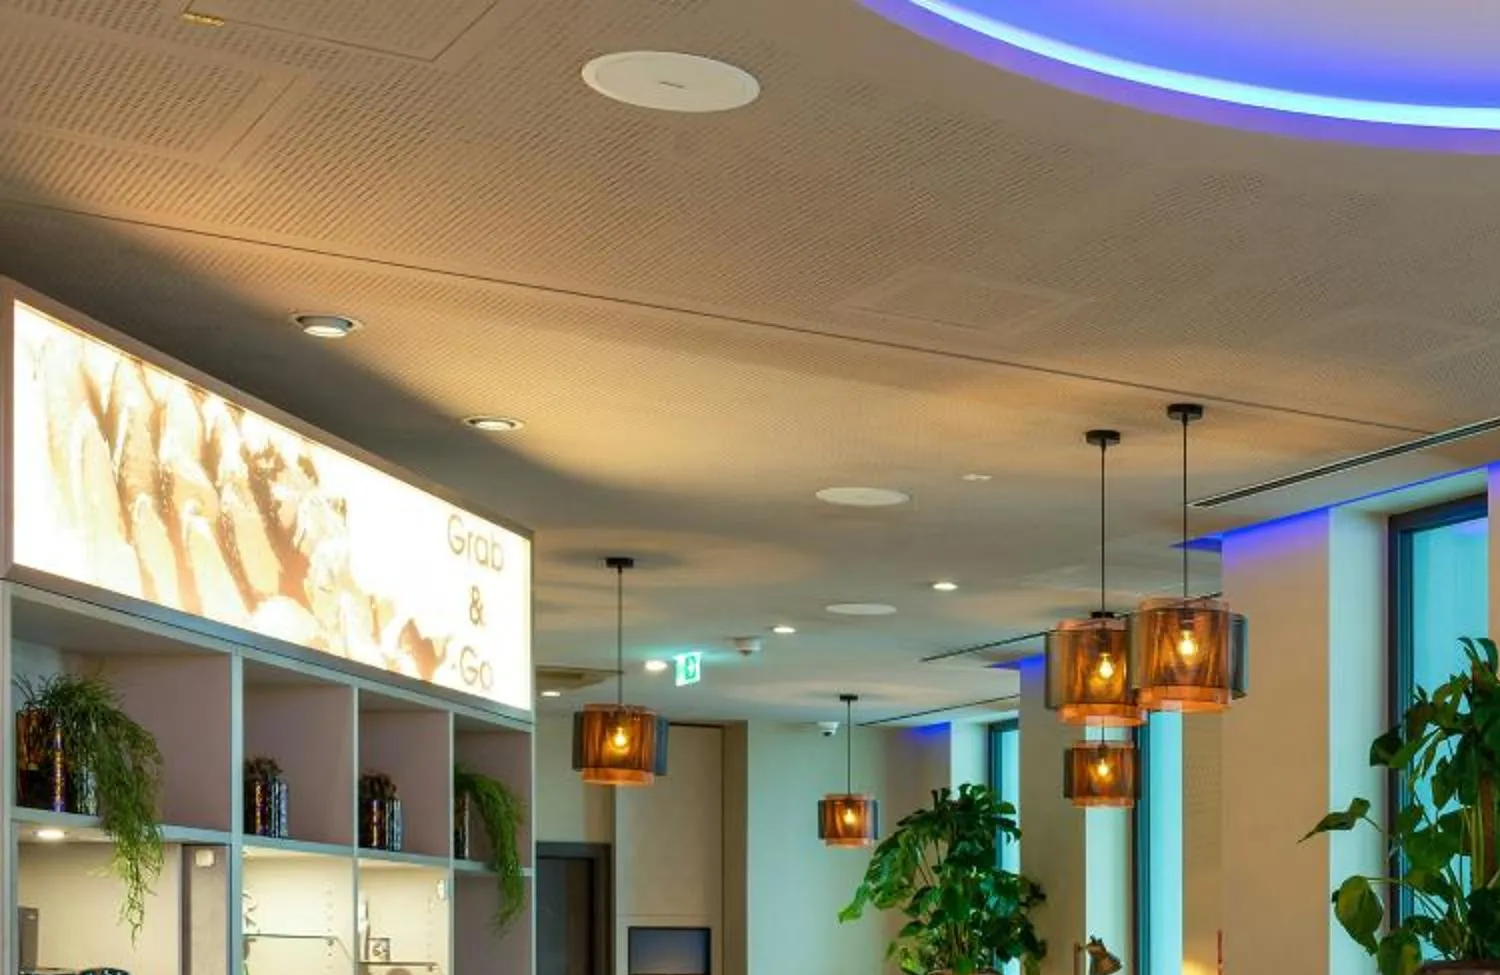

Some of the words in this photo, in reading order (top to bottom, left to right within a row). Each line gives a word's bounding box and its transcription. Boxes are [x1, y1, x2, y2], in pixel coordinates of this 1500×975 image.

[447, 514, 505, 572] Grab
[469, 585, 486, 627] &
[459, 645, 494, 691] Go
